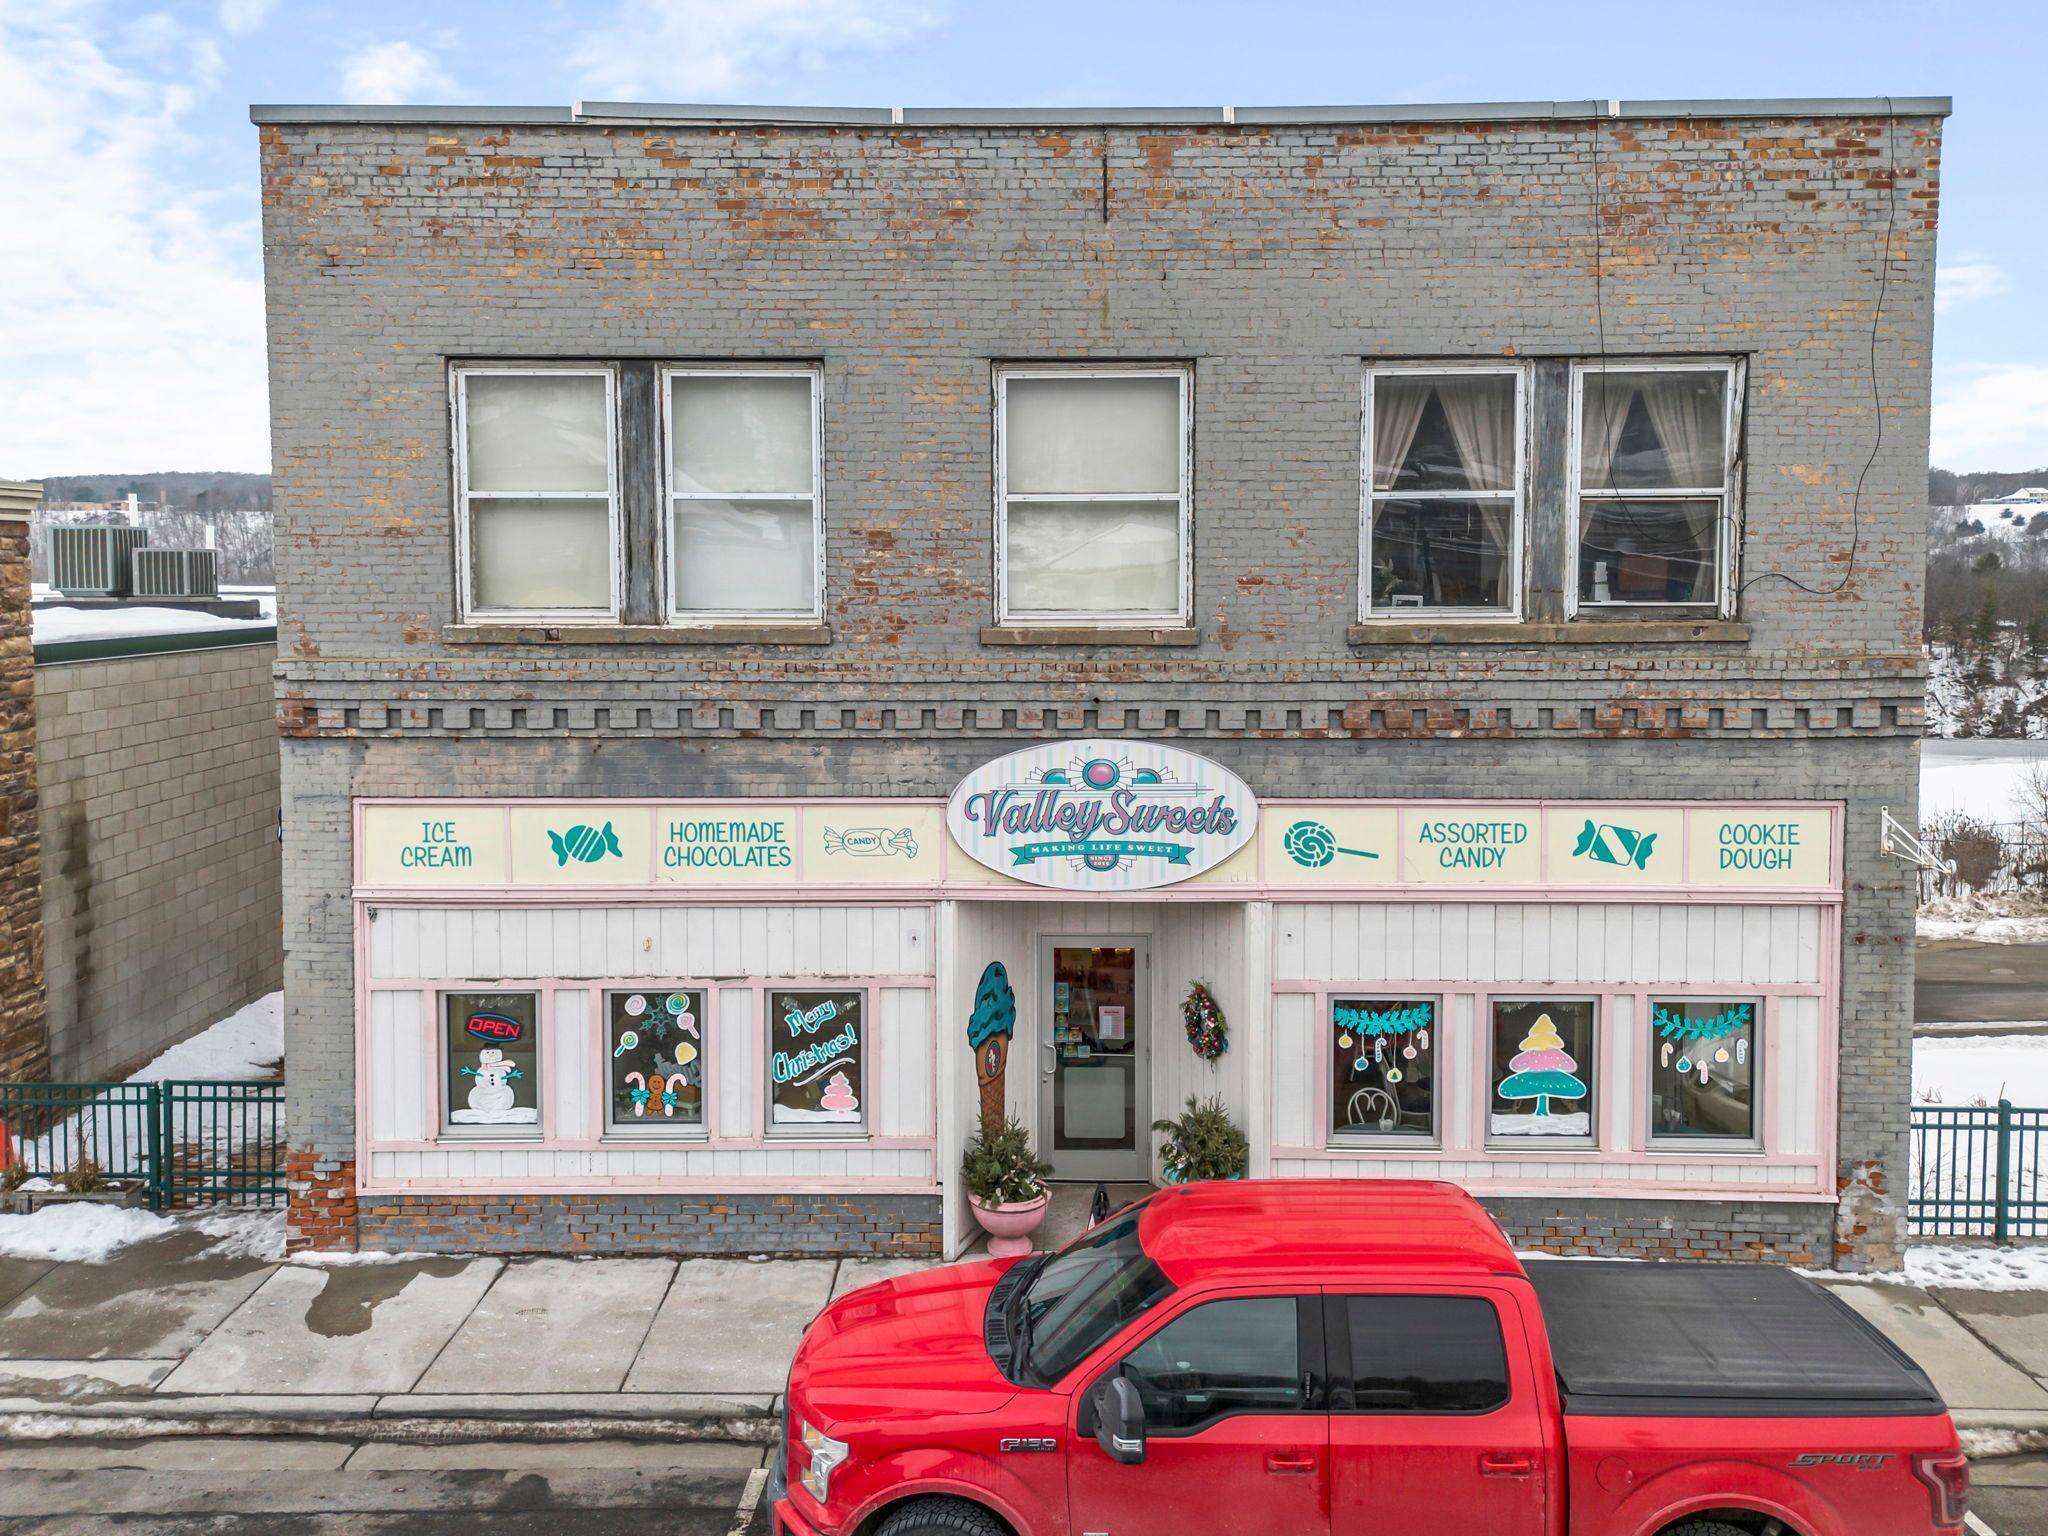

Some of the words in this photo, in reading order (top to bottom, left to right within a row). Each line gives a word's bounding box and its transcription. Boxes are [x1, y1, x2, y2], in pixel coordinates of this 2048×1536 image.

[964, 789, 1104, 842] Valley
[1102, 789, 1238, 836] Sweets
[422, 821, 456, 844] ICE
[670, 821, 784, 844] HOMEMADE
[847, 837, 877, 846] CANDY
[1420, 822, 1527, 845] ASSORTED
[1719, 823, 1800, 846] COOKIE
[401, 845, 472, 868] CREAM
[664, 845, 792, 868] CHOCOLATES
[1031, 844, 1085, 853] MAKING
[1127, 844, 1173, 853] SWEET
[1440, 847, 1505, 869] CANDY
[1719, 847, 1792, 870] DOUGH
[468, 1018, 520, 1038] OPEN
[784, 1000, 836, 1037] Merry
[773, 1023, 858, 1083] Christmas!
[1787, 1453, 1896, 1466] SPORT
